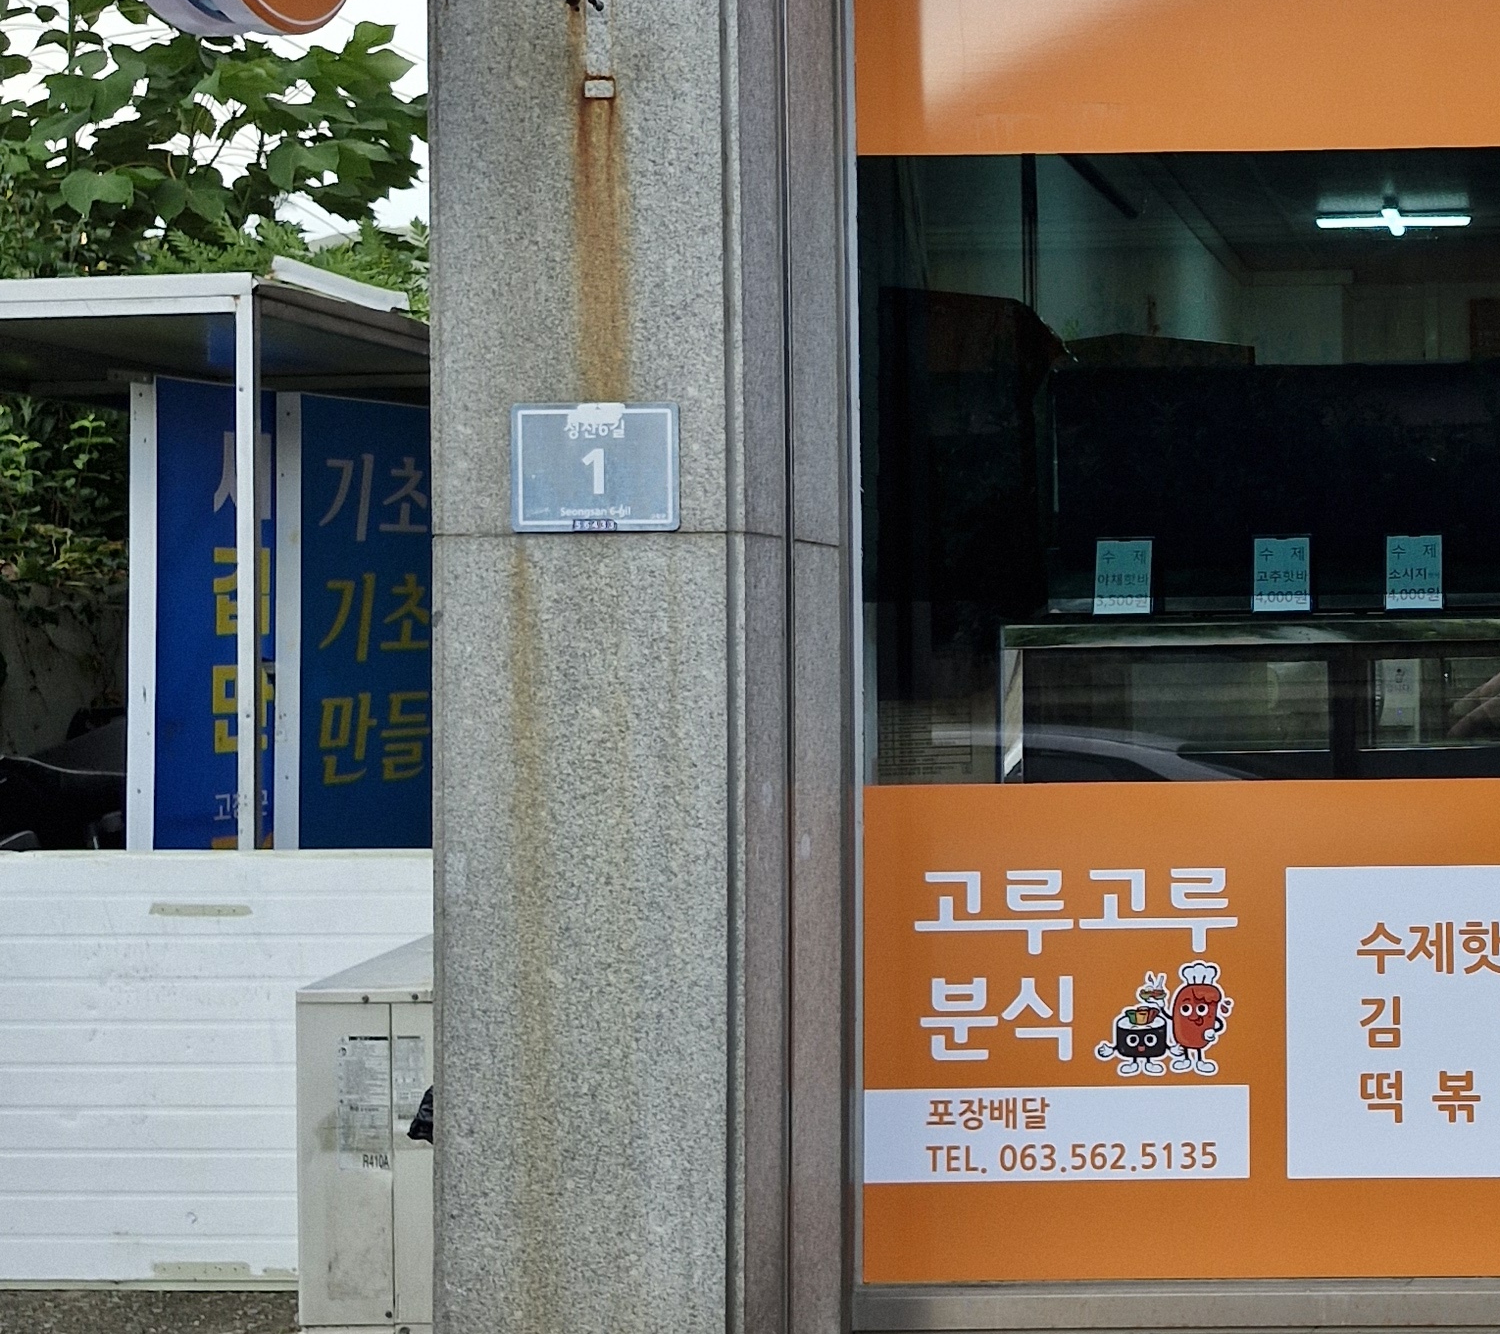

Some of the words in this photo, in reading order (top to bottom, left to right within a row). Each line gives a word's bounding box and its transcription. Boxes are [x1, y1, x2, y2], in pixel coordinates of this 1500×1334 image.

[582, 447, 605, 495] 1
[318, 452, 428, 543] 기초
[560, 506, 607, 519] Seongsan
[1256, 569, 1307, 583] 고추핫바
[1255, 589, 1308, 604] 4,000원
[1388, 587, 1440, 602] 4,000원
[318, 571, 429, 663] 기초
[914, 868, 1239, 955] 고루고루
[920, 975, 1075, 1062] 분식
[925, 1096, 1051, 1131] 포장배달
[926, 1144, 988, 1174] TEL.
[999, 1141, 1218, 1173] 063.562.5135
